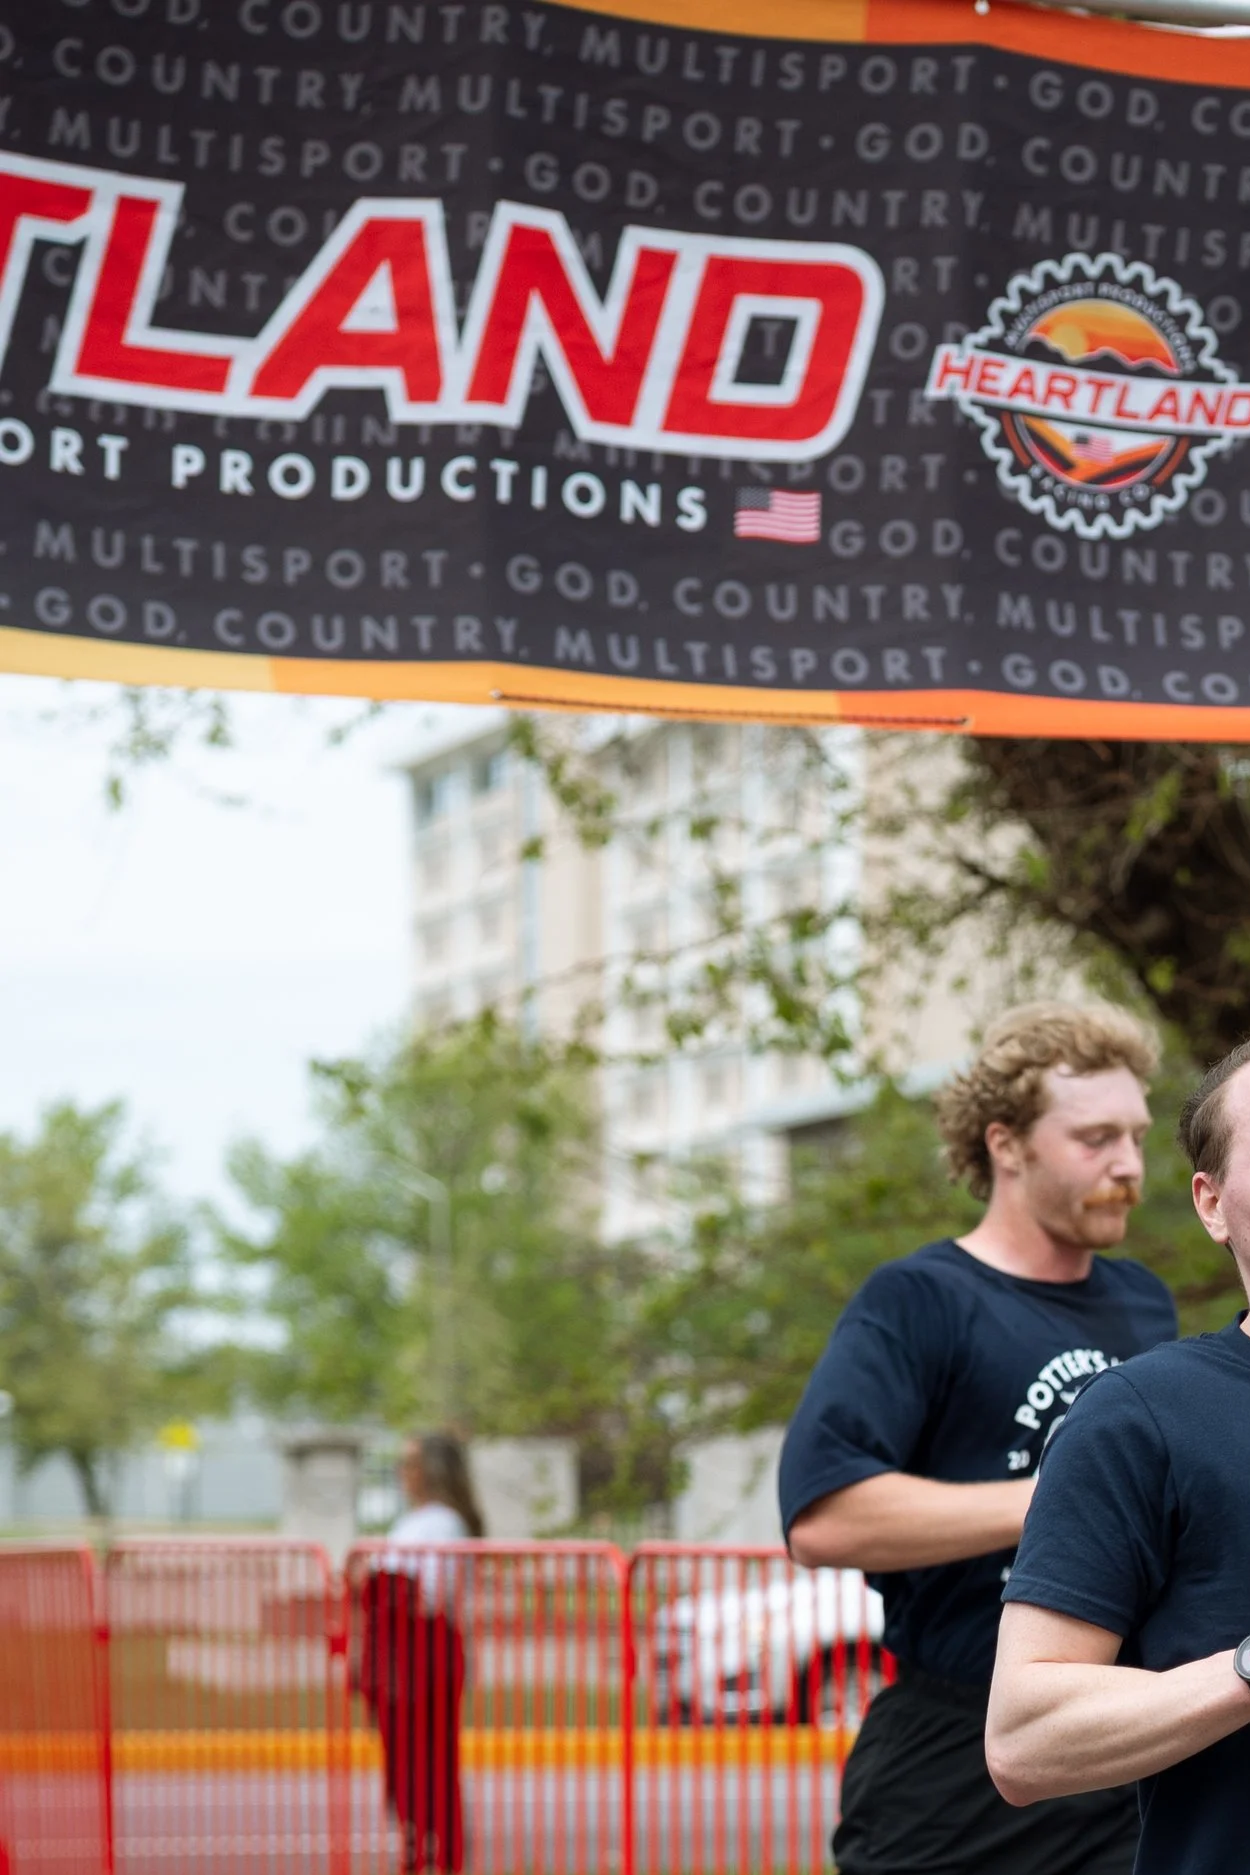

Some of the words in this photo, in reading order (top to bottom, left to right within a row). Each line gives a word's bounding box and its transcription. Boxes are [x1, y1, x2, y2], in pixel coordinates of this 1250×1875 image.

[578, 24, 976, 95] MULTISPORT
[48, 106, 468, 183] MULTISPORT
[398, 73, 803, 158] MULTISPORT
[172, 443, 709, 532] PRODUCTIONS
[34, 519, 447, 590] MULTISPORT
[555, 624, 947, 684] MULTISPORT
